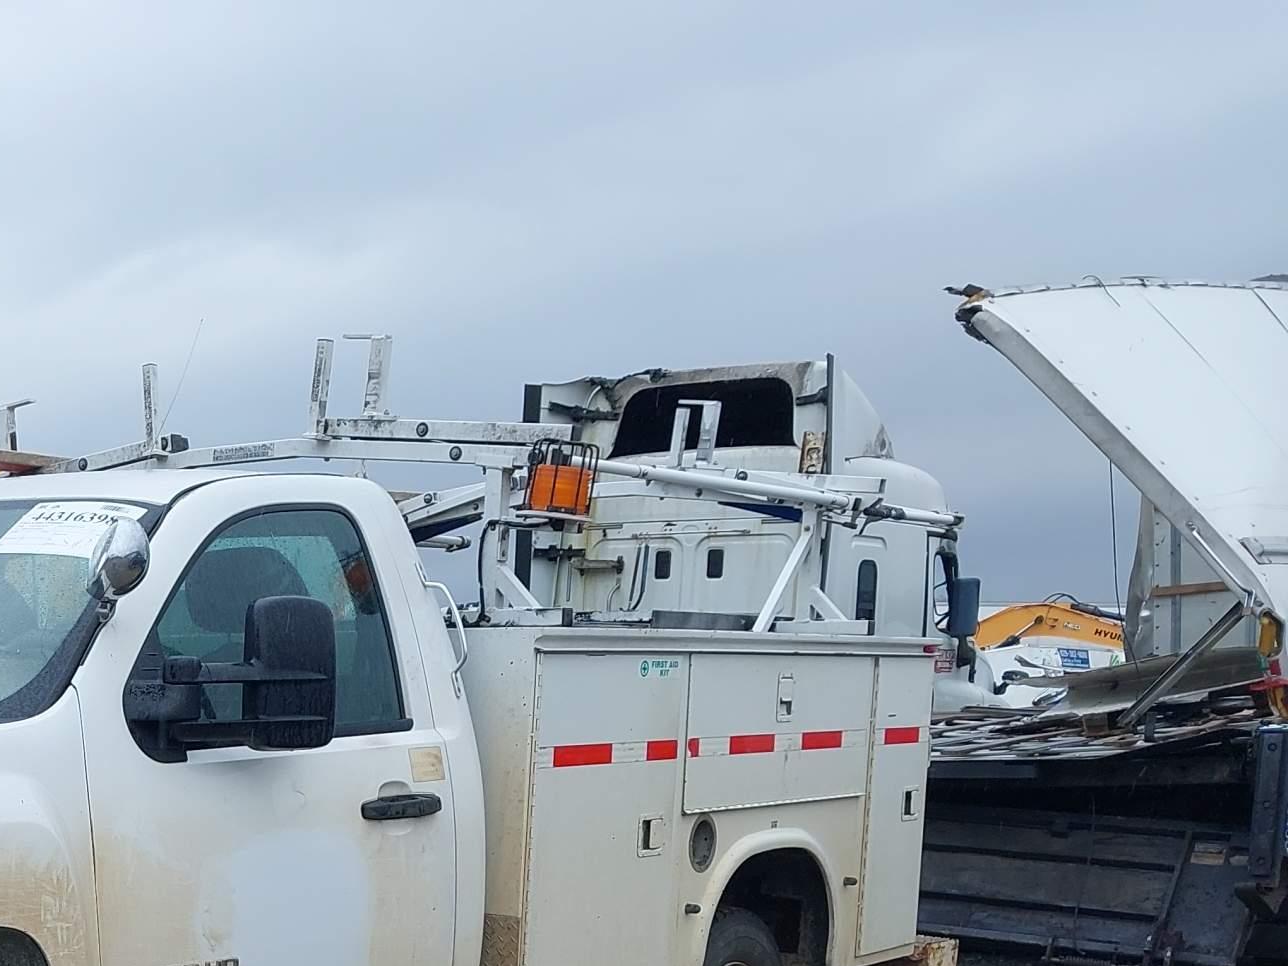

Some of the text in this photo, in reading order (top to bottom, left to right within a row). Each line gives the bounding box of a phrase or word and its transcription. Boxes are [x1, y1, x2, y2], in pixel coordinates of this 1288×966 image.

[32, 511, 118, 526] 44316398
[652, 660, 679, 668] FIRST AID
[660, 669, 670, 677] KIT
